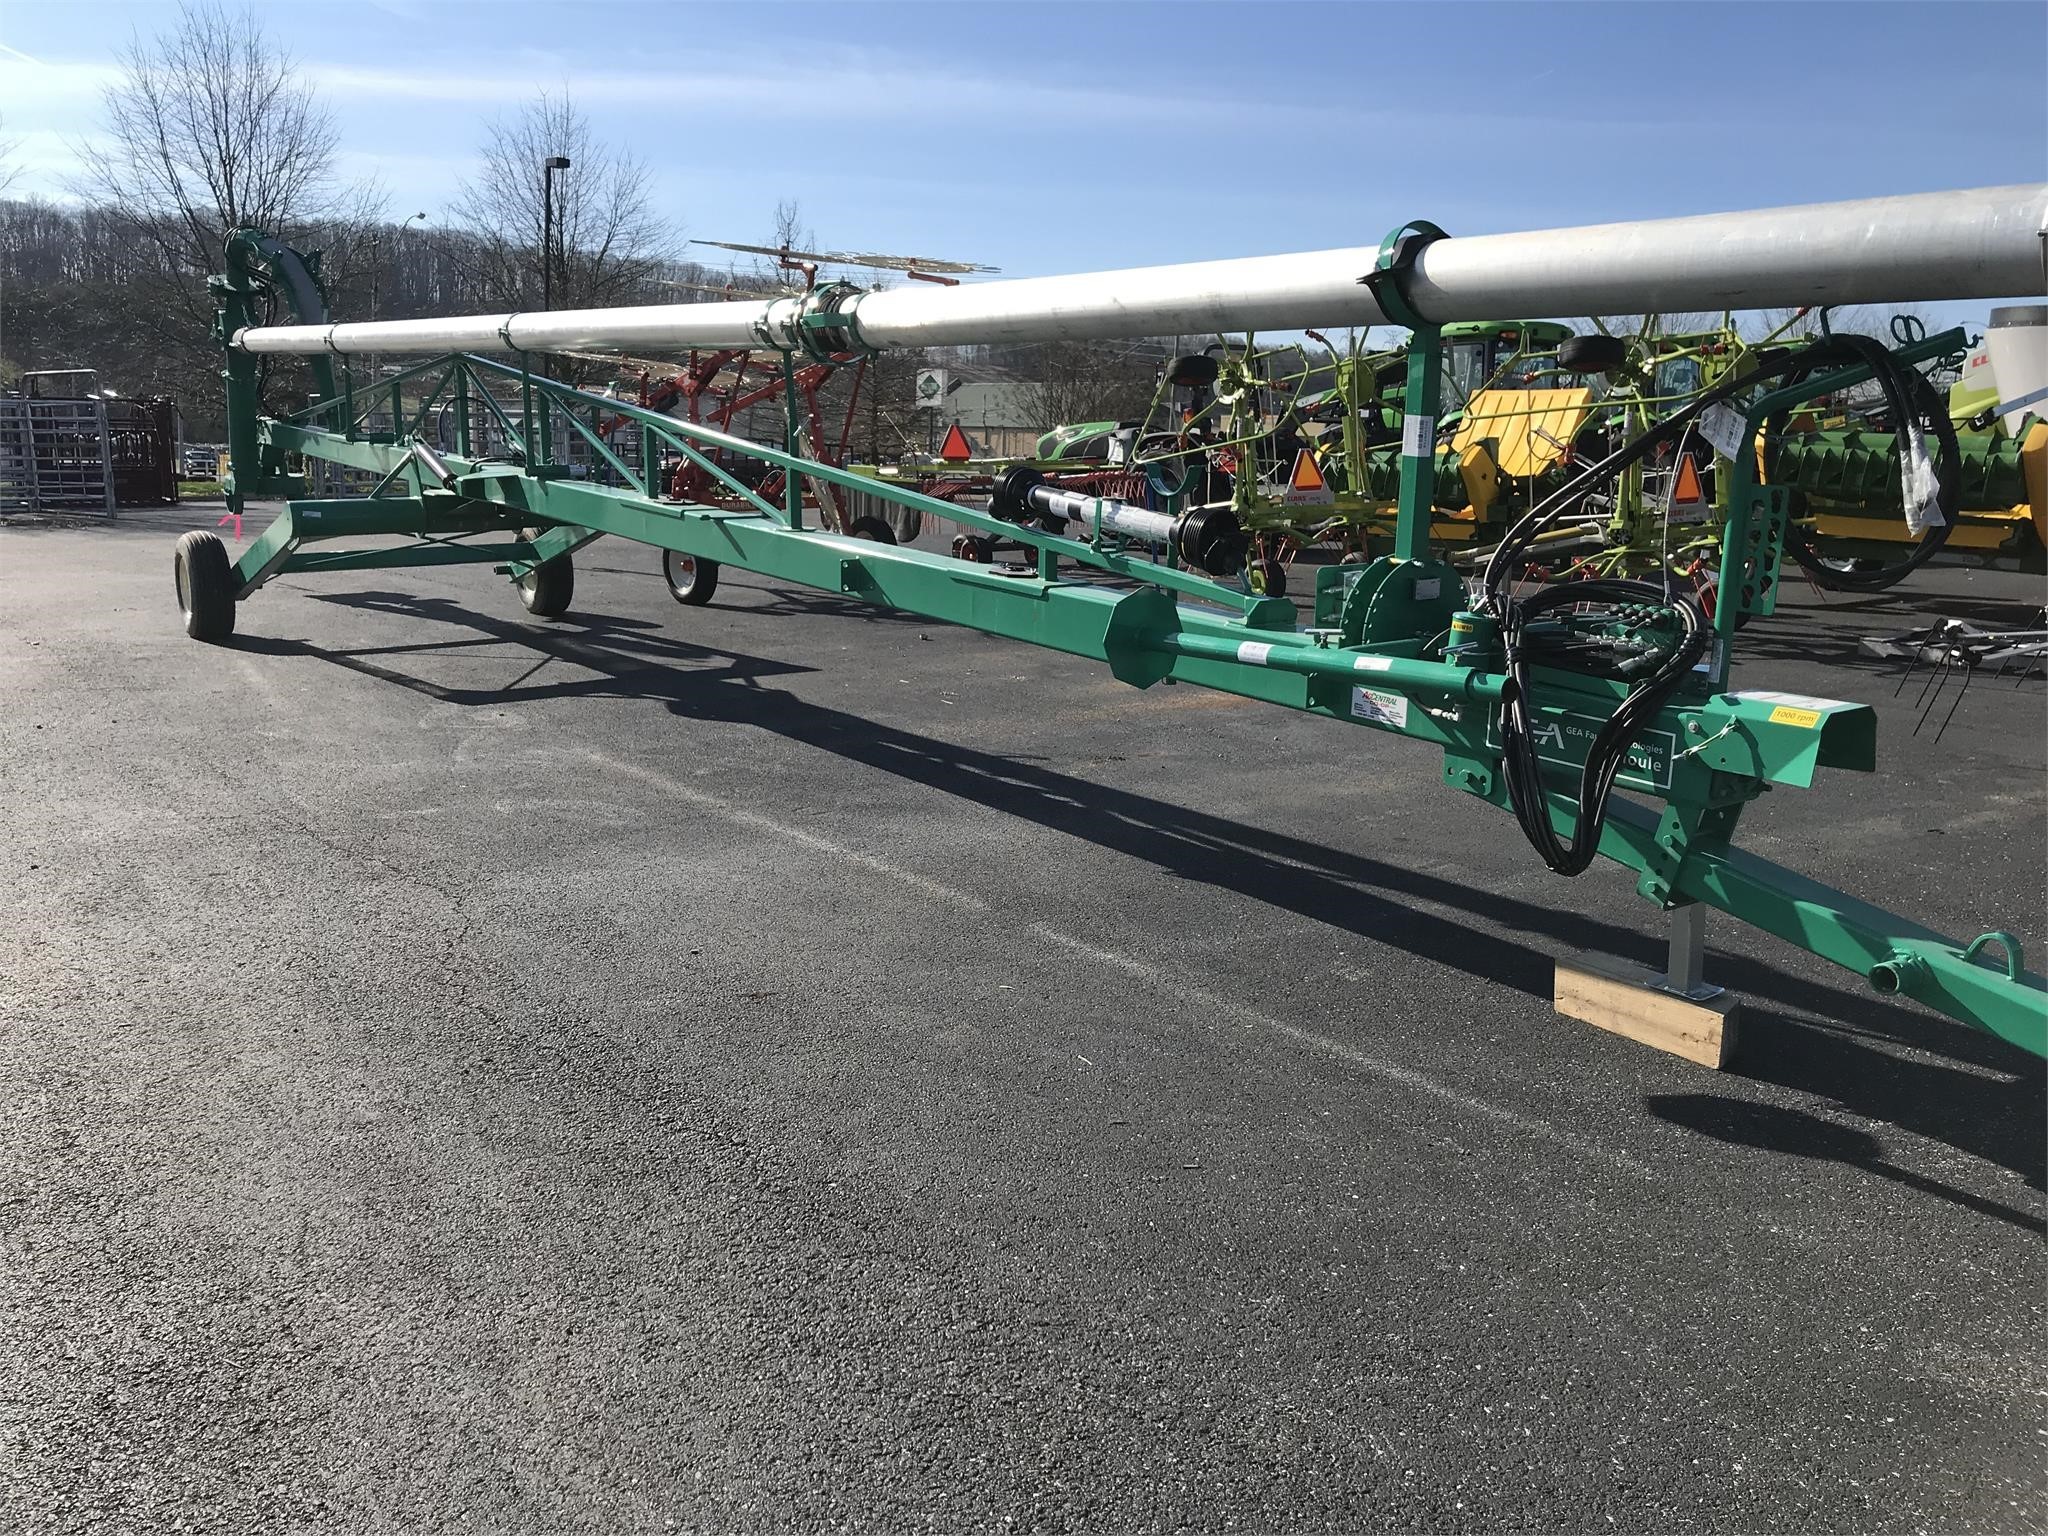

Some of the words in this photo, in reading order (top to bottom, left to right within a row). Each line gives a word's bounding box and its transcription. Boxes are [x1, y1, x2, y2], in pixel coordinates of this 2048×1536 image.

[721, 501, 756, 510] DURABIL
[1776, 711, 1797, 719] 1000
[1566, 726, 1584, 738] GEA
[1630, 741, 1663, 755] ologies
